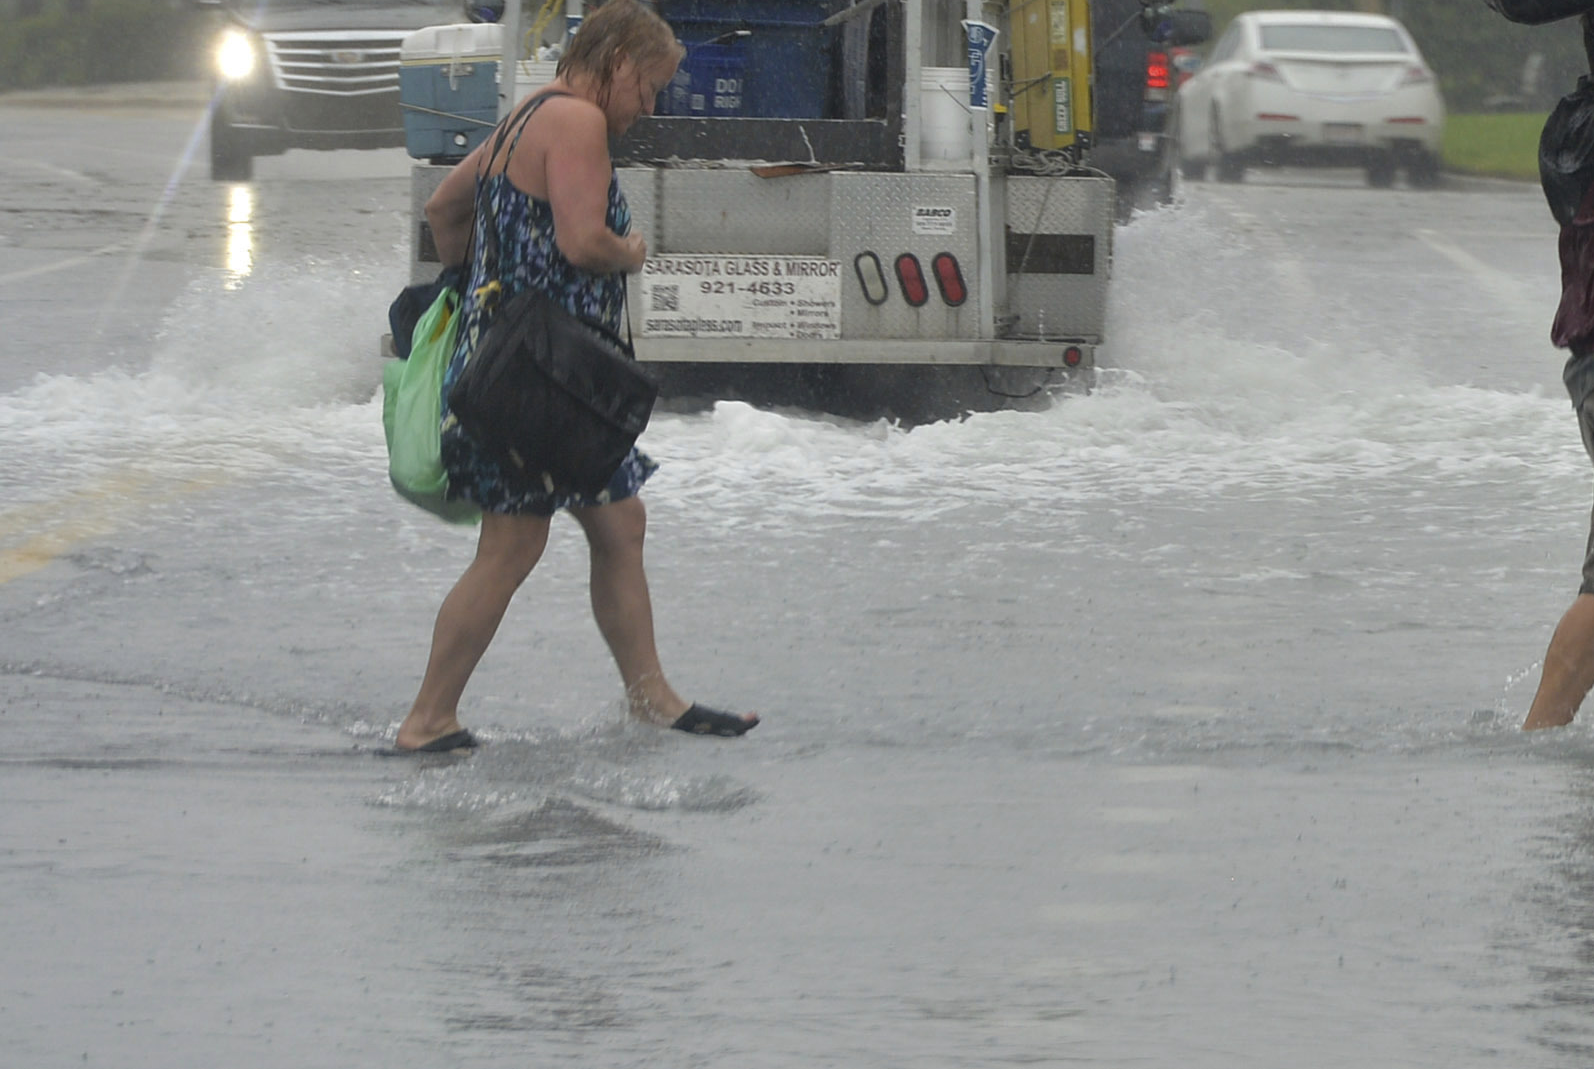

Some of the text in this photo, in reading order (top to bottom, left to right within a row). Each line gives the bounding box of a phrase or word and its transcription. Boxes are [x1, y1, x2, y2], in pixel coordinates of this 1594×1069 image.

[645, 260, 838, 277] SARASOTA GLASS & MIRROR
[701, 281, 795, 295] 921-4633
[797, 298, 836, 308] Showers
[797, 309, 829, 318] Mirrors
[797, 321, 837, 330] Windows
